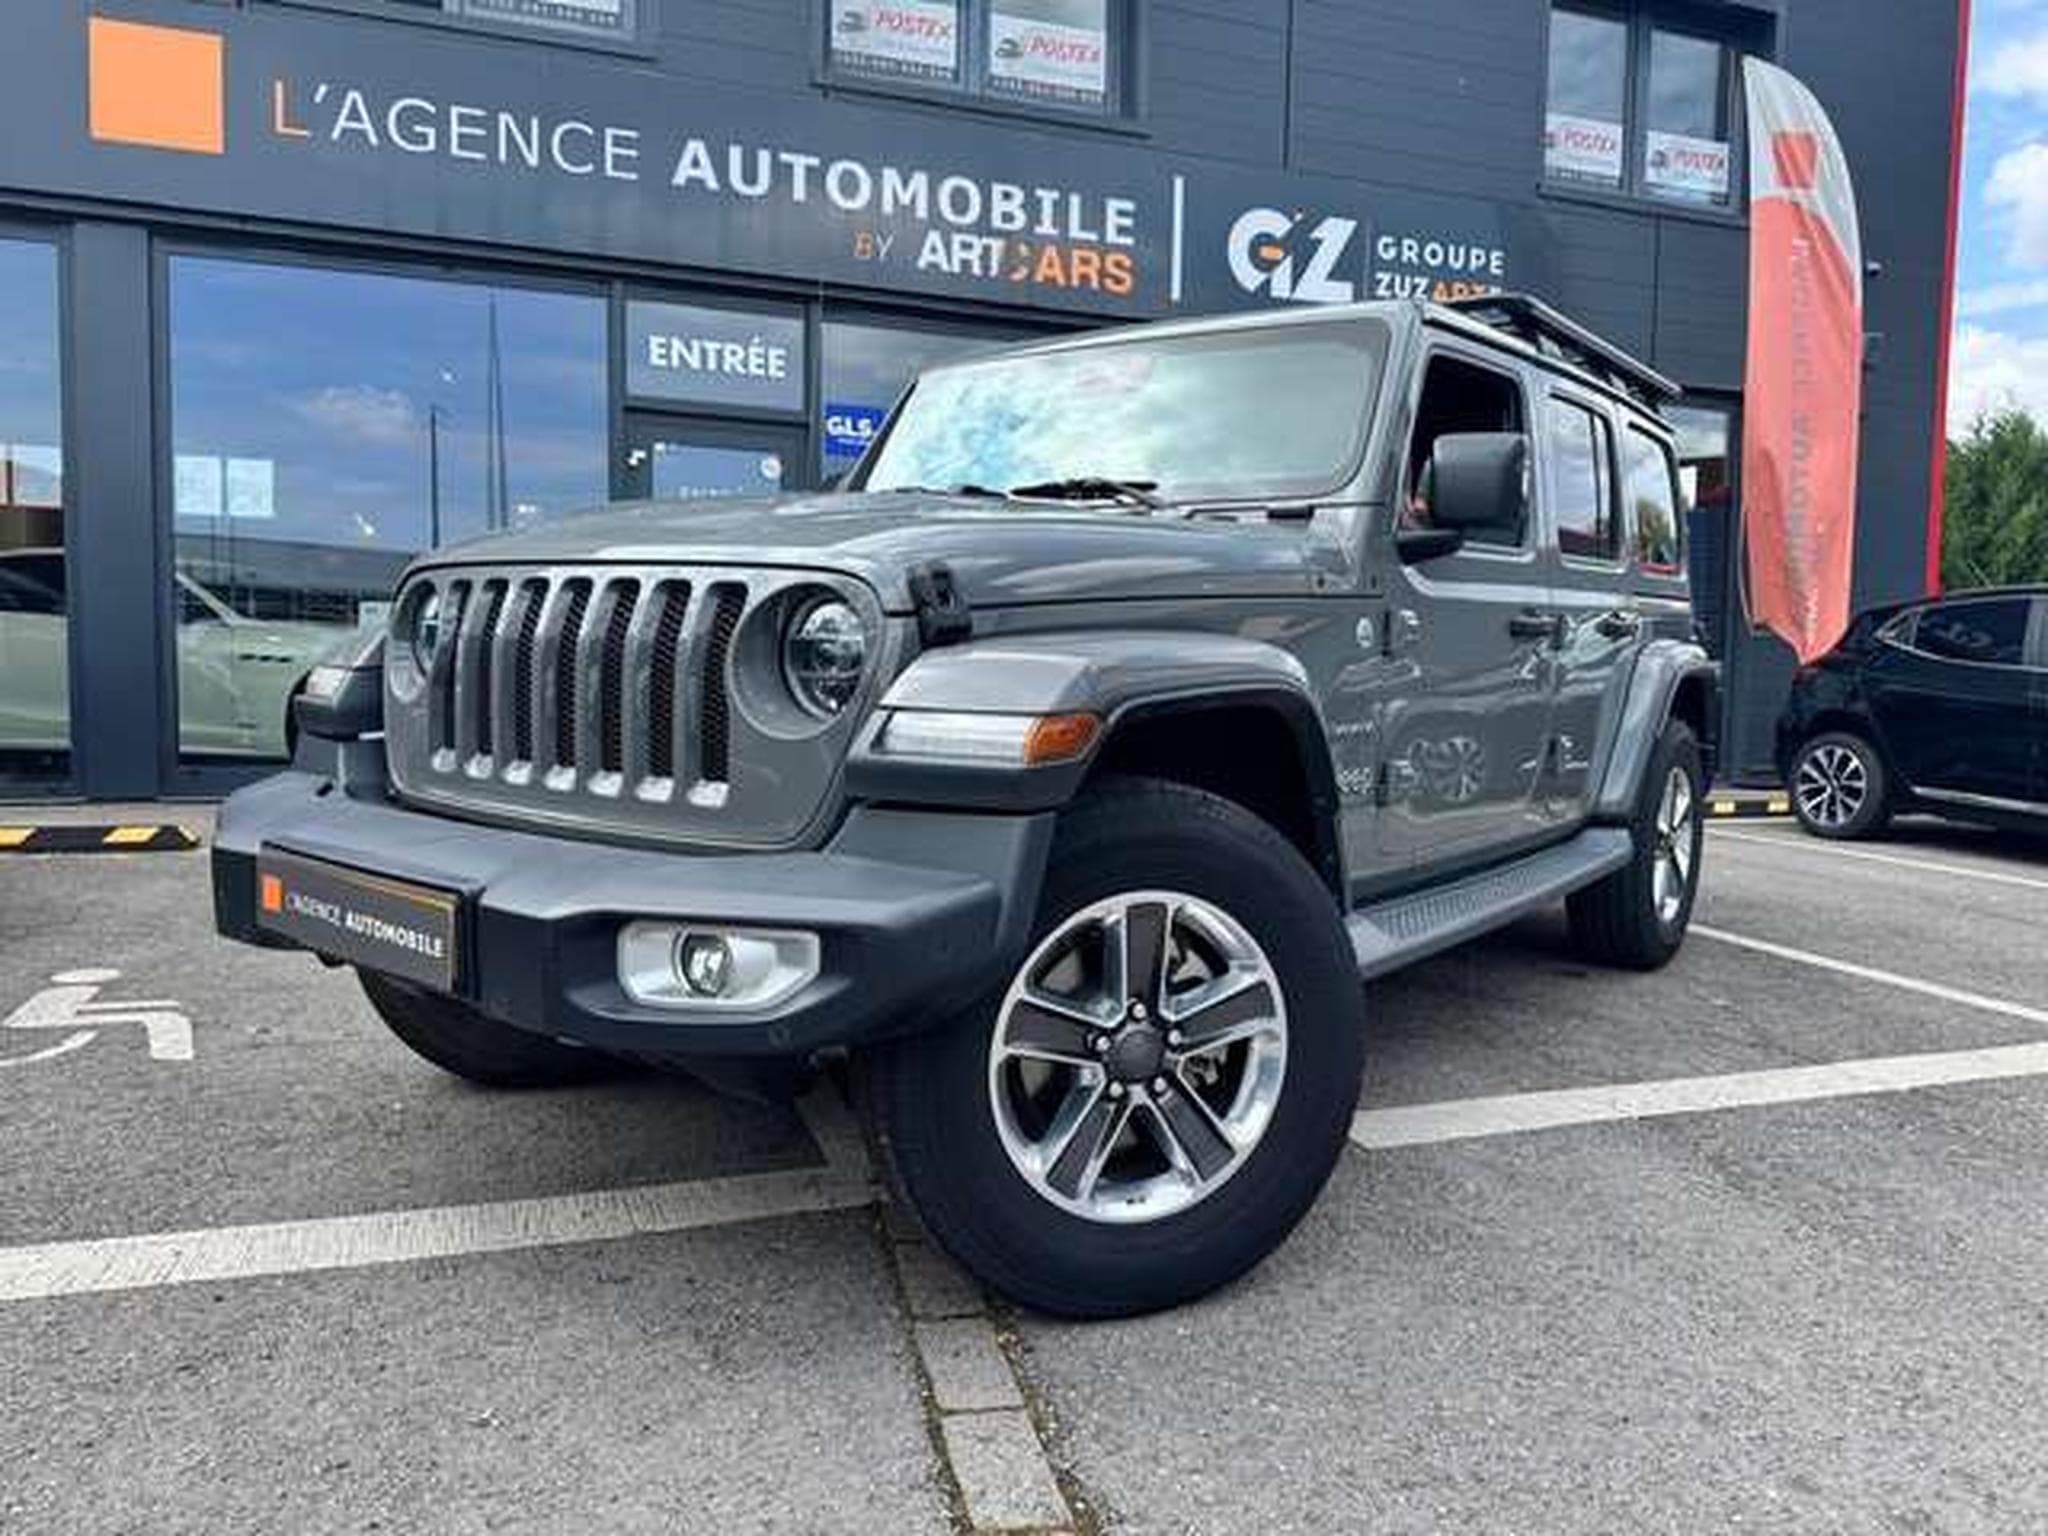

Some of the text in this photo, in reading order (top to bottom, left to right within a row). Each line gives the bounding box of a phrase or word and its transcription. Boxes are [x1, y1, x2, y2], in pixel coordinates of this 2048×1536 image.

[273, 78, 1137, 246] L'AGENCE AUTOMOBILE
[853, 231, 895, 263] BY
[1376, 235, 1506, 276] GROUPE
[648, 331, 788, 379] ENTRÉE
[345, 909, 444, 958] AUTOMOBILE
